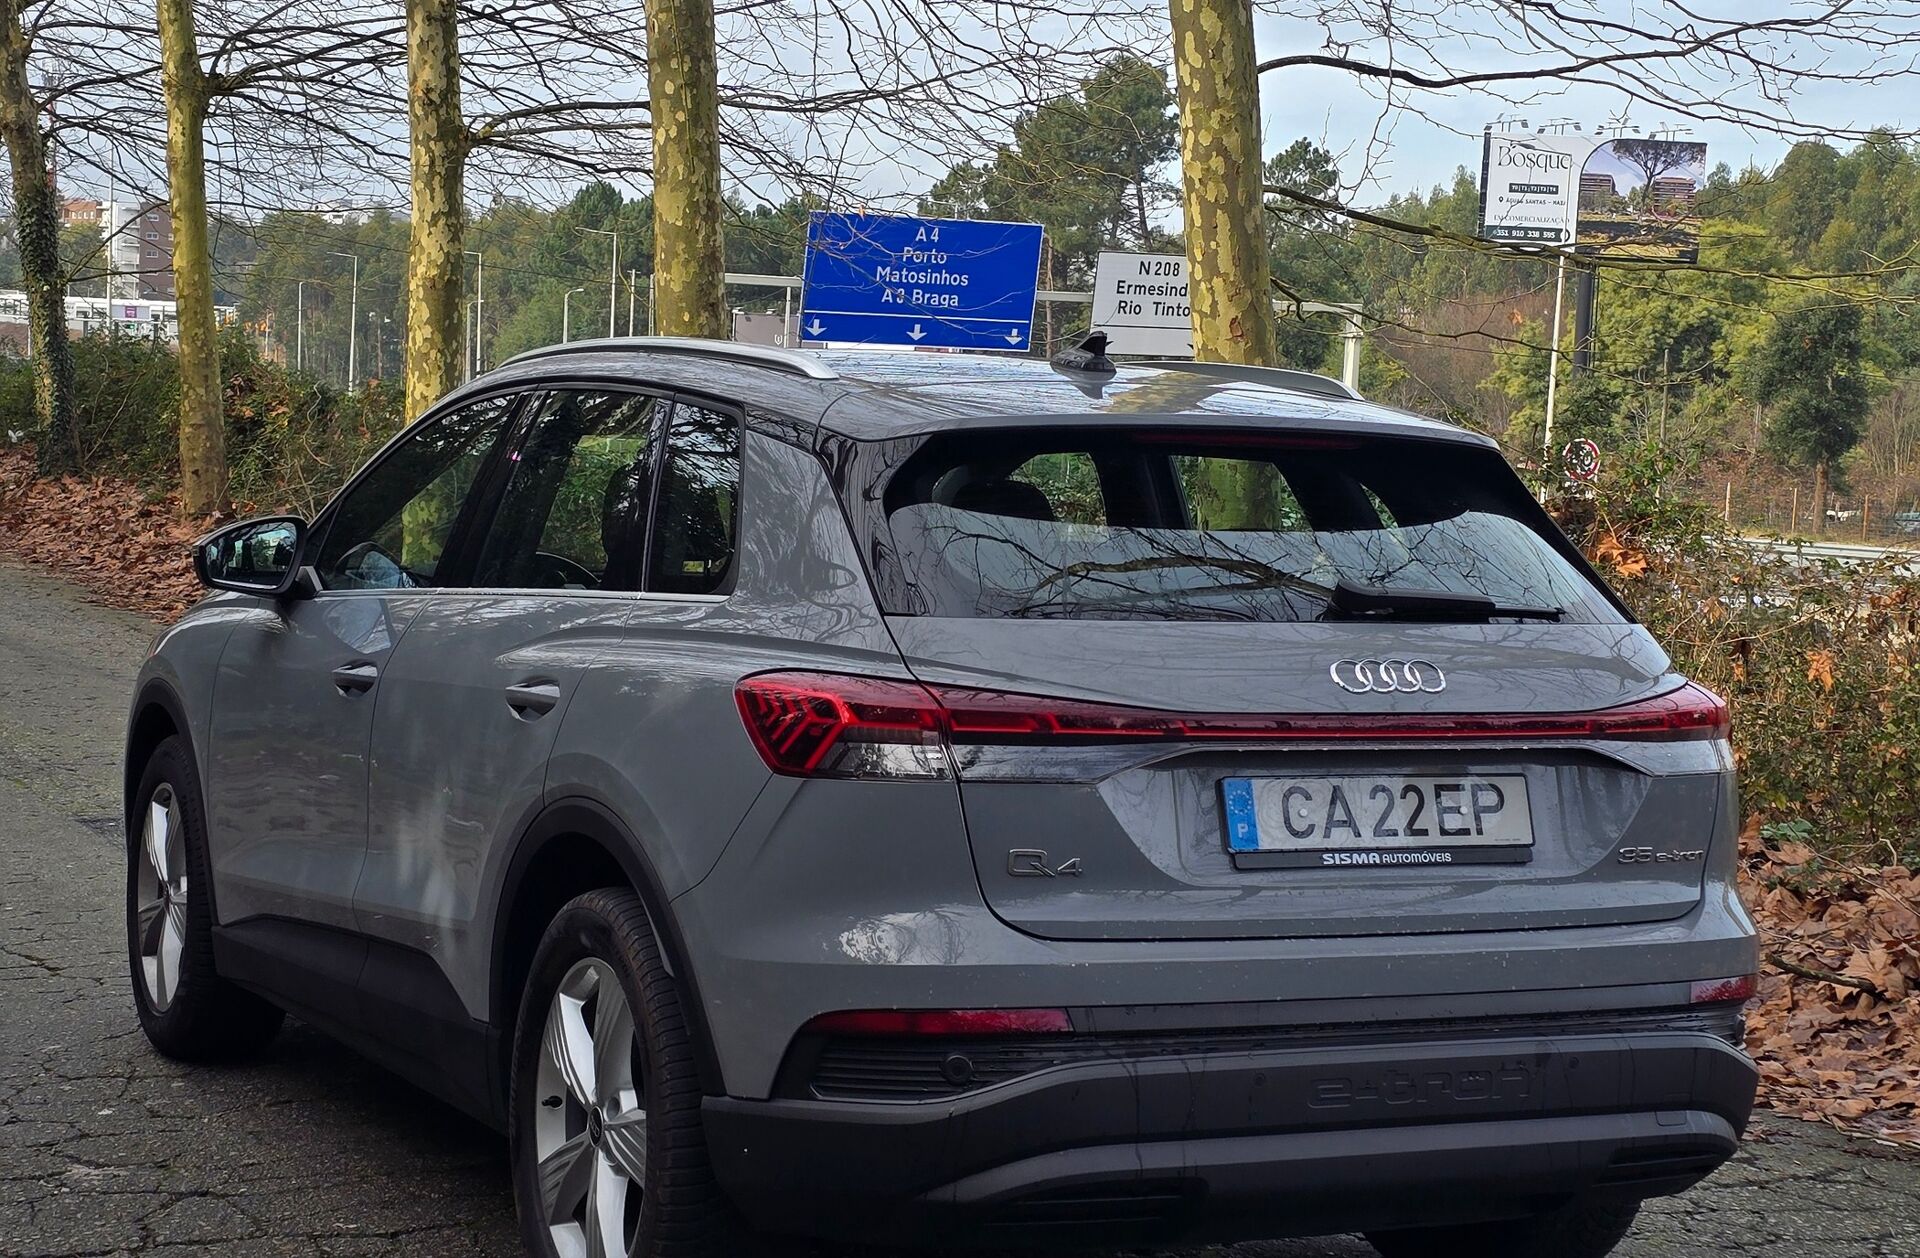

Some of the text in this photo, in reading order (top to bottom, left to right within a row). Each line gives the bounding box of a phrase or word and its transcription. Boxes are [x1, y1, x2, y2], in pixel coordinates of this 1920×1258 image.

[1498, 146, 1571, 173] Bosque
[915, 226, 939, 243] A 4
[903, 246, 947, 264] Porto
[876, 266, 969, 286] Matosinhos
[1138, 260, 1180, 277] N 208
[1116, 280, 1188, 297] Ermesind
[881, 289, 893, 303] A
[912, 289, 959, 308] Braga
[1117, 300, 1191, 317] Rio Tinto
[1237, 823, 1249, 838] P
[1008, 848, 1082, 877] Q4
[1323, 851, 1452, 865] SISMA AUTOMÓVEIS
